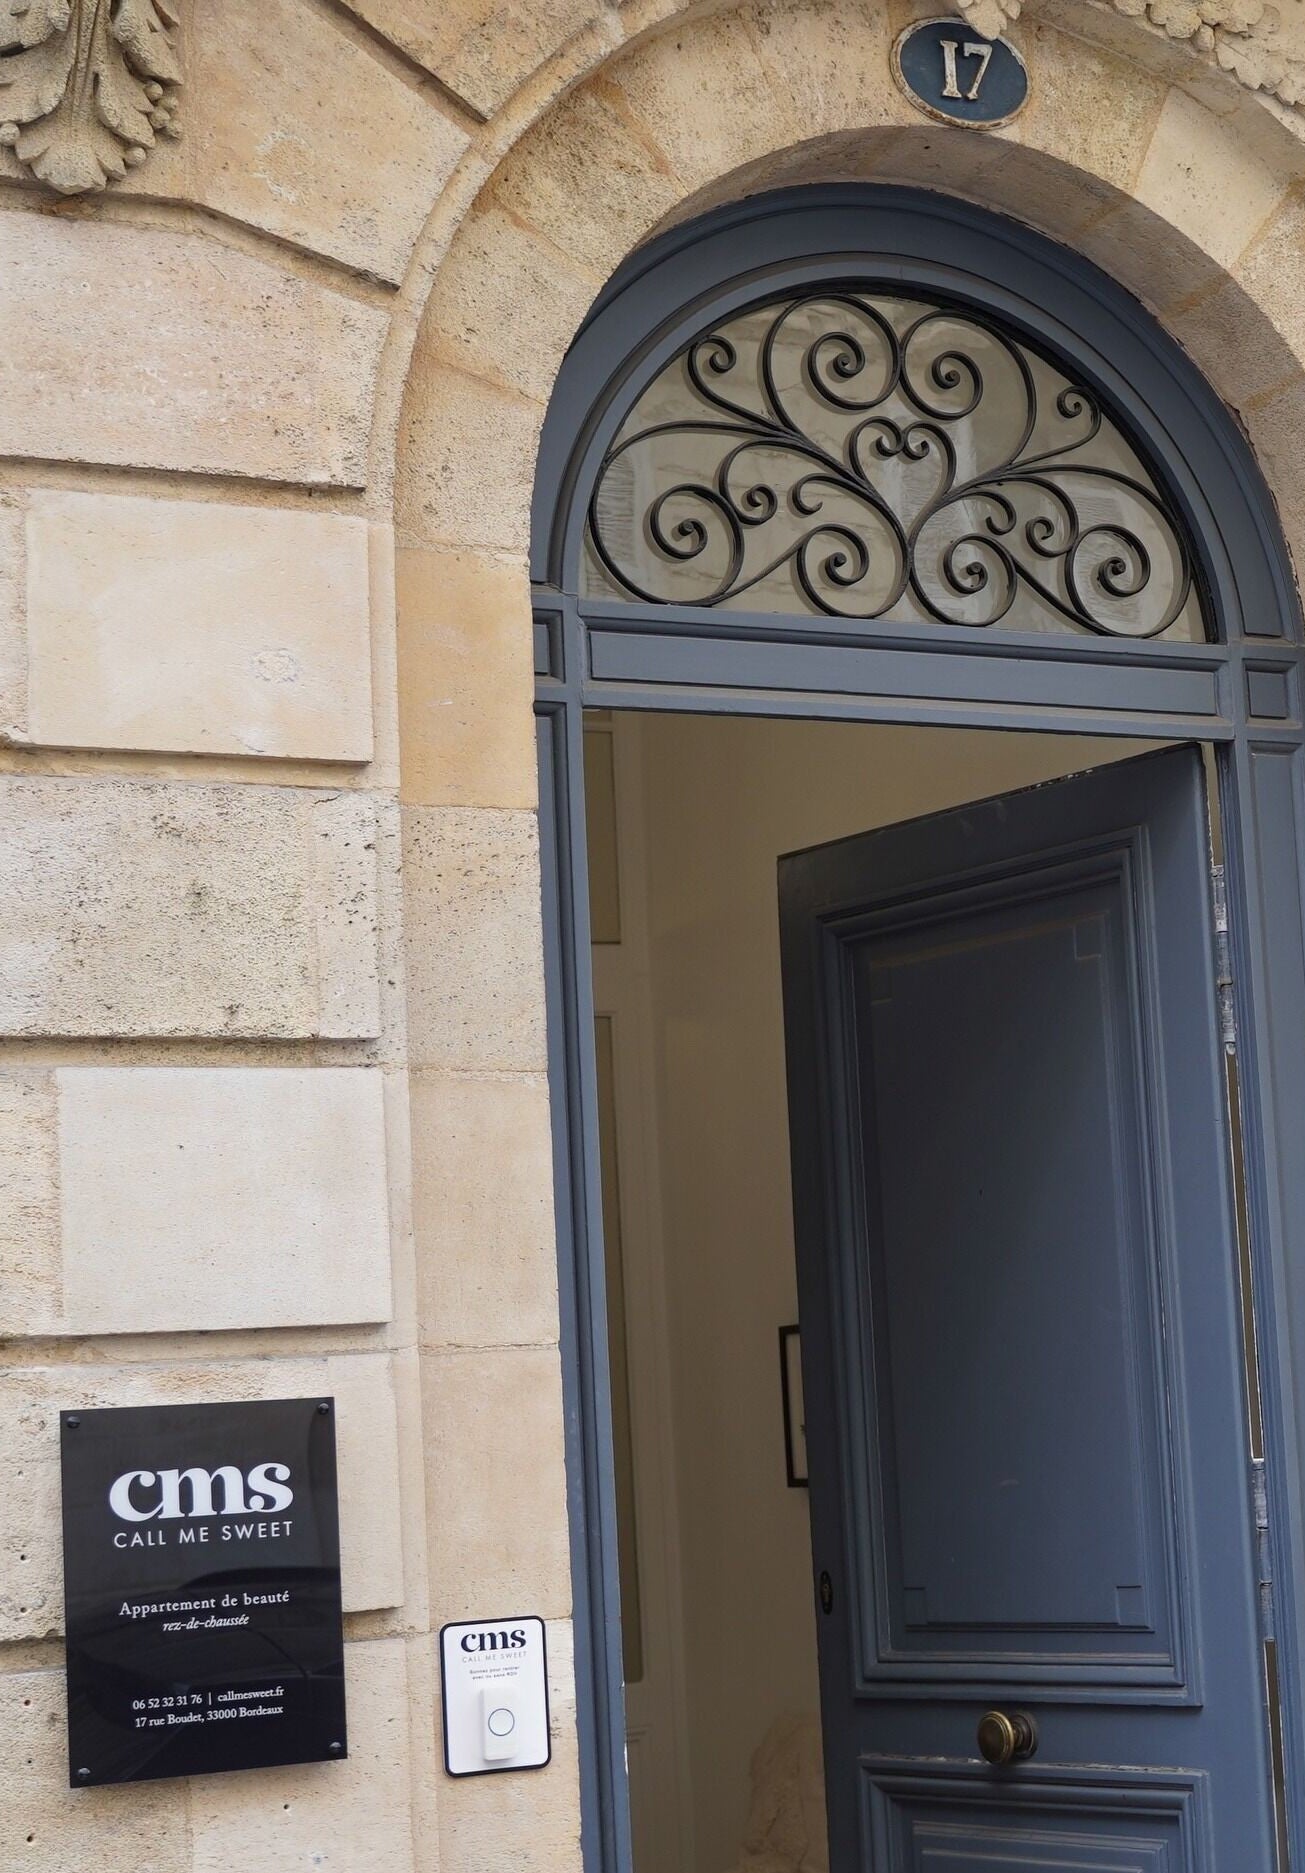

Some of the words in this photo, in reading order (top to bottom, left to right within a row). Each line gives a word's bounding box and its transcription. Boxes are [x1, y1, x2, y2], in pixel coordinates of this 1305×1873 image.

[939, 39, 993, 101] 17
[109, 1462, 294, 1522] cms
[113, 1530, 166, 1548] CALL
[179, 1526, 209, 1544] ME
[221, 1521, 293, 1541] SWEET
[118, 1597, 216, 1618] Appartement
[221, 1594, 238, 1607] de
[243, 1590, 290, 1605] beauté
[162, 1613, 250, 1631] rez-de-chaussée
[460, 1629, 527, 1653] cms
[462, 1655, 481, 1663] CALL
[500, 1651, 527, 1660] SWEET
[132, 1700, 146, 1710] 06
[147, 1698, 160, 1708] 52
[161, 1697, 174, 1707] 32
[176, 1695, 188, 1706] 31
[190, 1694, 203, 1704] 76
[217, 1686, 285, 1702] callmesweet.fr
[135, 1717, 146, 1728] 17
[148, 1716, 165, 1727] rue
[167, 1712, 205, 1725] Boudet,
[206, 1708, 237, 1721] 33000
[239, 1705, 284, 1718] Bordeaux
